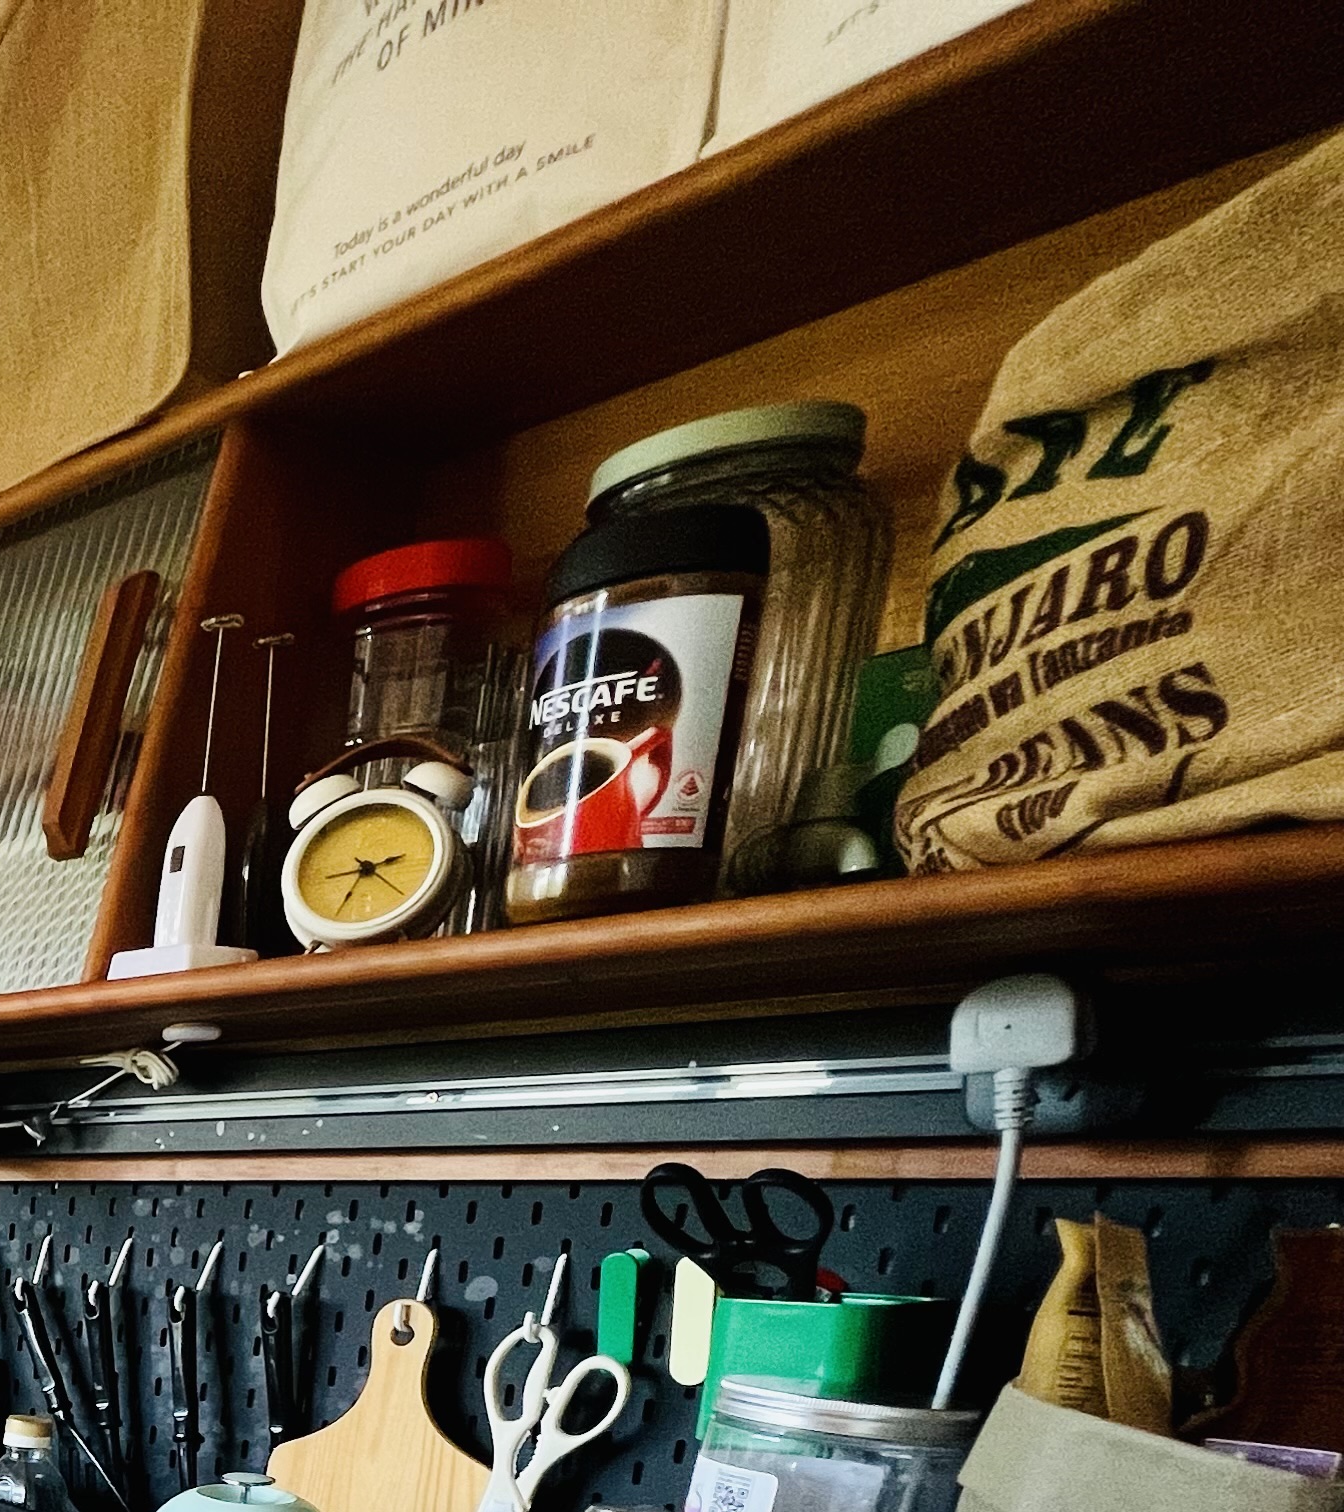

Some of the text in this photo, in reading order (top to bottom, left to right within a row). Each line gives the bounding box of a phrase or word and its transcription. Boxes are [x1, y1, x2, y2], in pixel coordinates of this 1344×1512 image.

[377, 24, 410, 72] OF
[321, 254, 367, 290] START
[374, 226, 417, 258] YOUR
[422, 205, 456, 233] DAY
[463, 175, 509, 209] WITH
[515, 166, 529, 182] A
[536, 133, 597, 172] SMILE
[333, 140, 526, 259] Today is a wonderful day
[543, 711, 621, 738] DELXE
